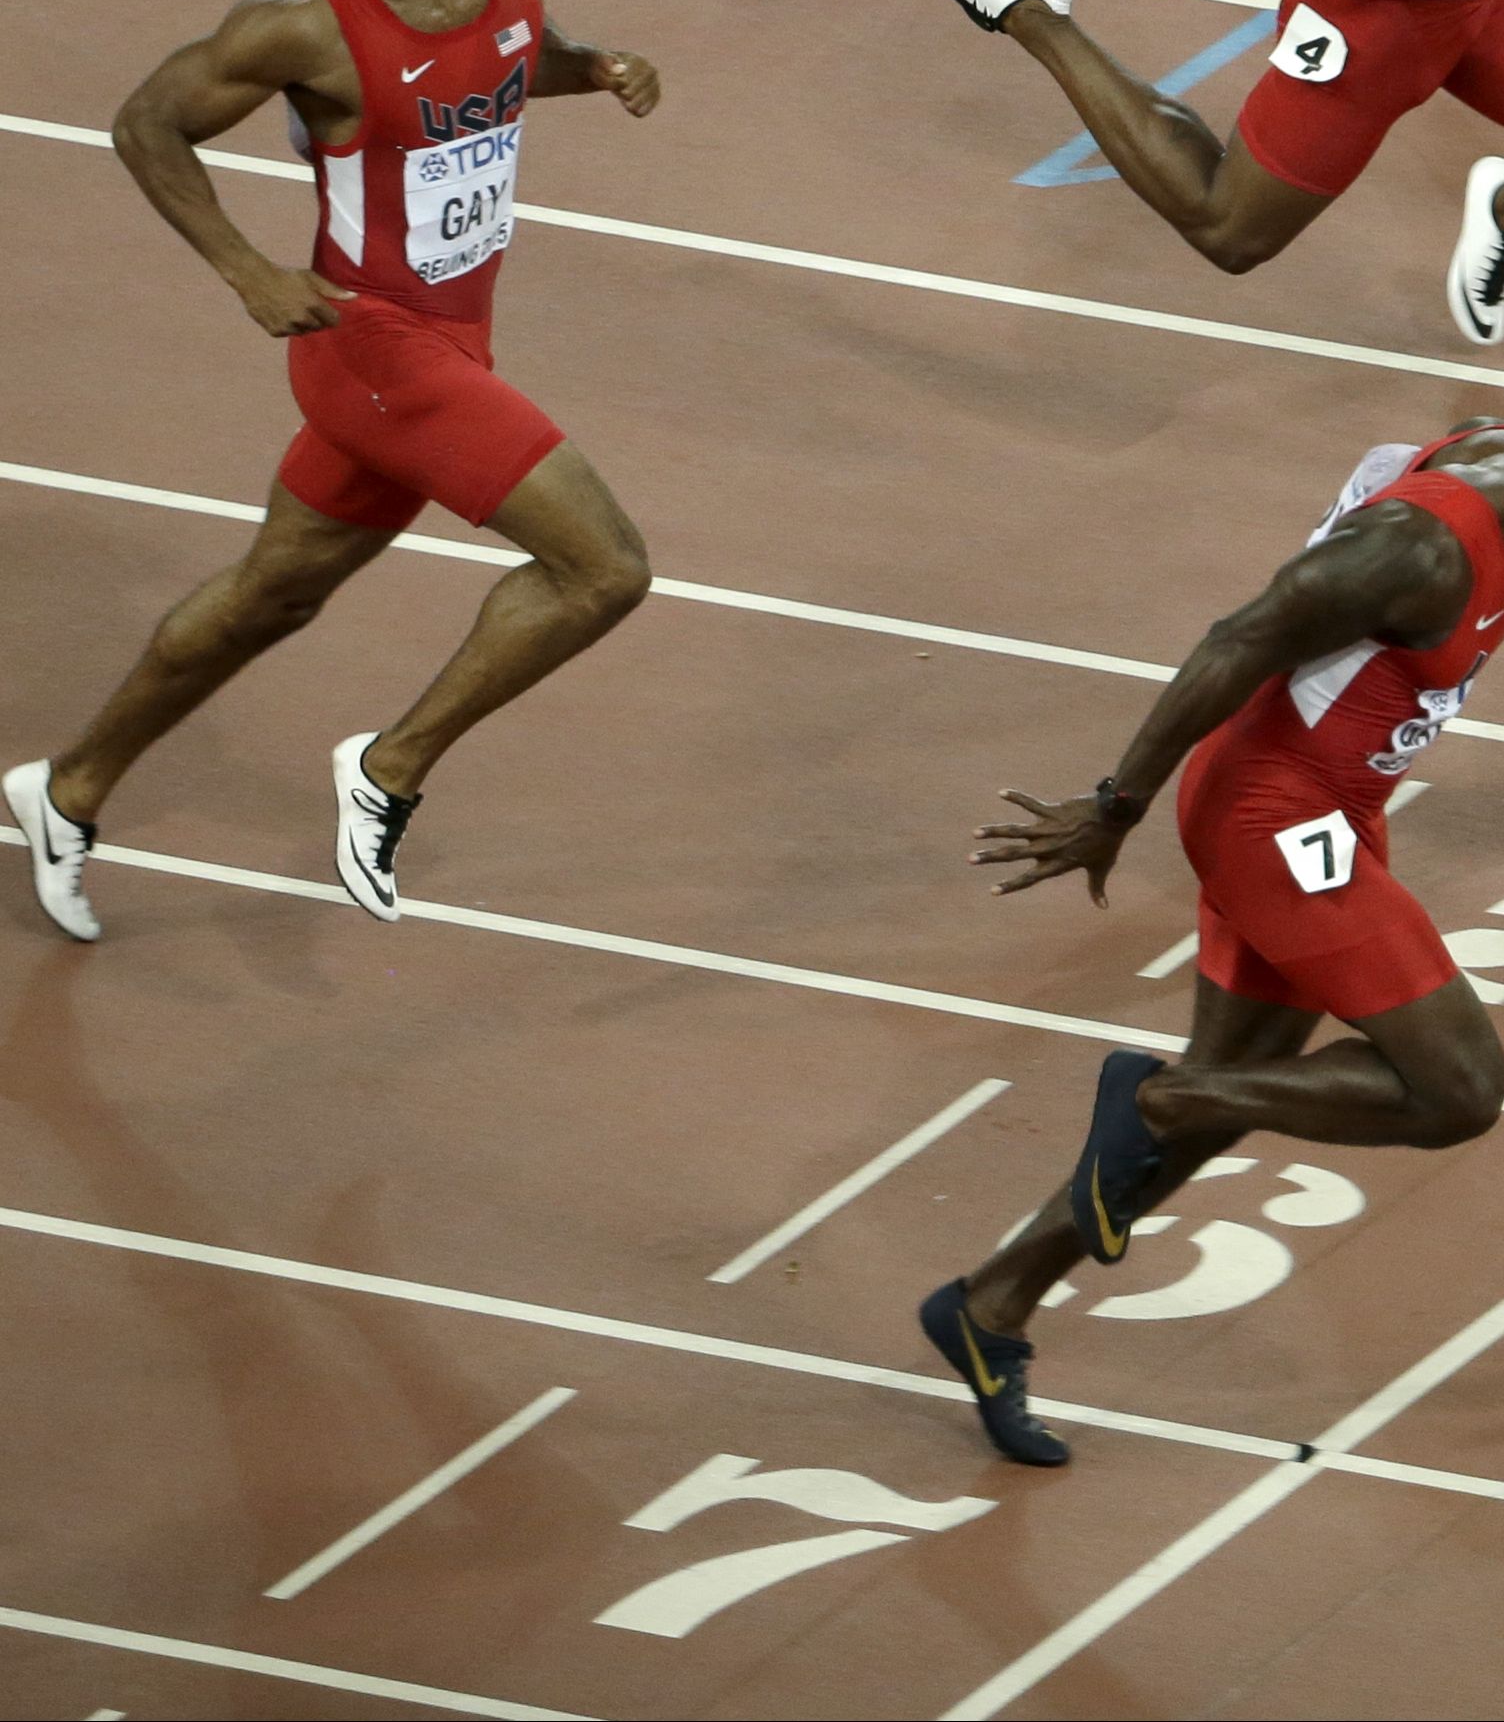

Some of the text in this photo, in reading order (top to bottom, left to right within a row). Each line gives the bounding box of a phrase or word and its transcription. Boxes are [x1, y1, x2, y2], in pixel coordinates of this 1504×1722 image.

[1295, 36, 1331, 75] 4
[417, 57, 527, 144] USA
[449, 126, 521, 175] TDK
[441, 180, 507, 241] GAY
[1300, 830, 1336, 881] 7
[594, 1453, 999, 1638] 7
